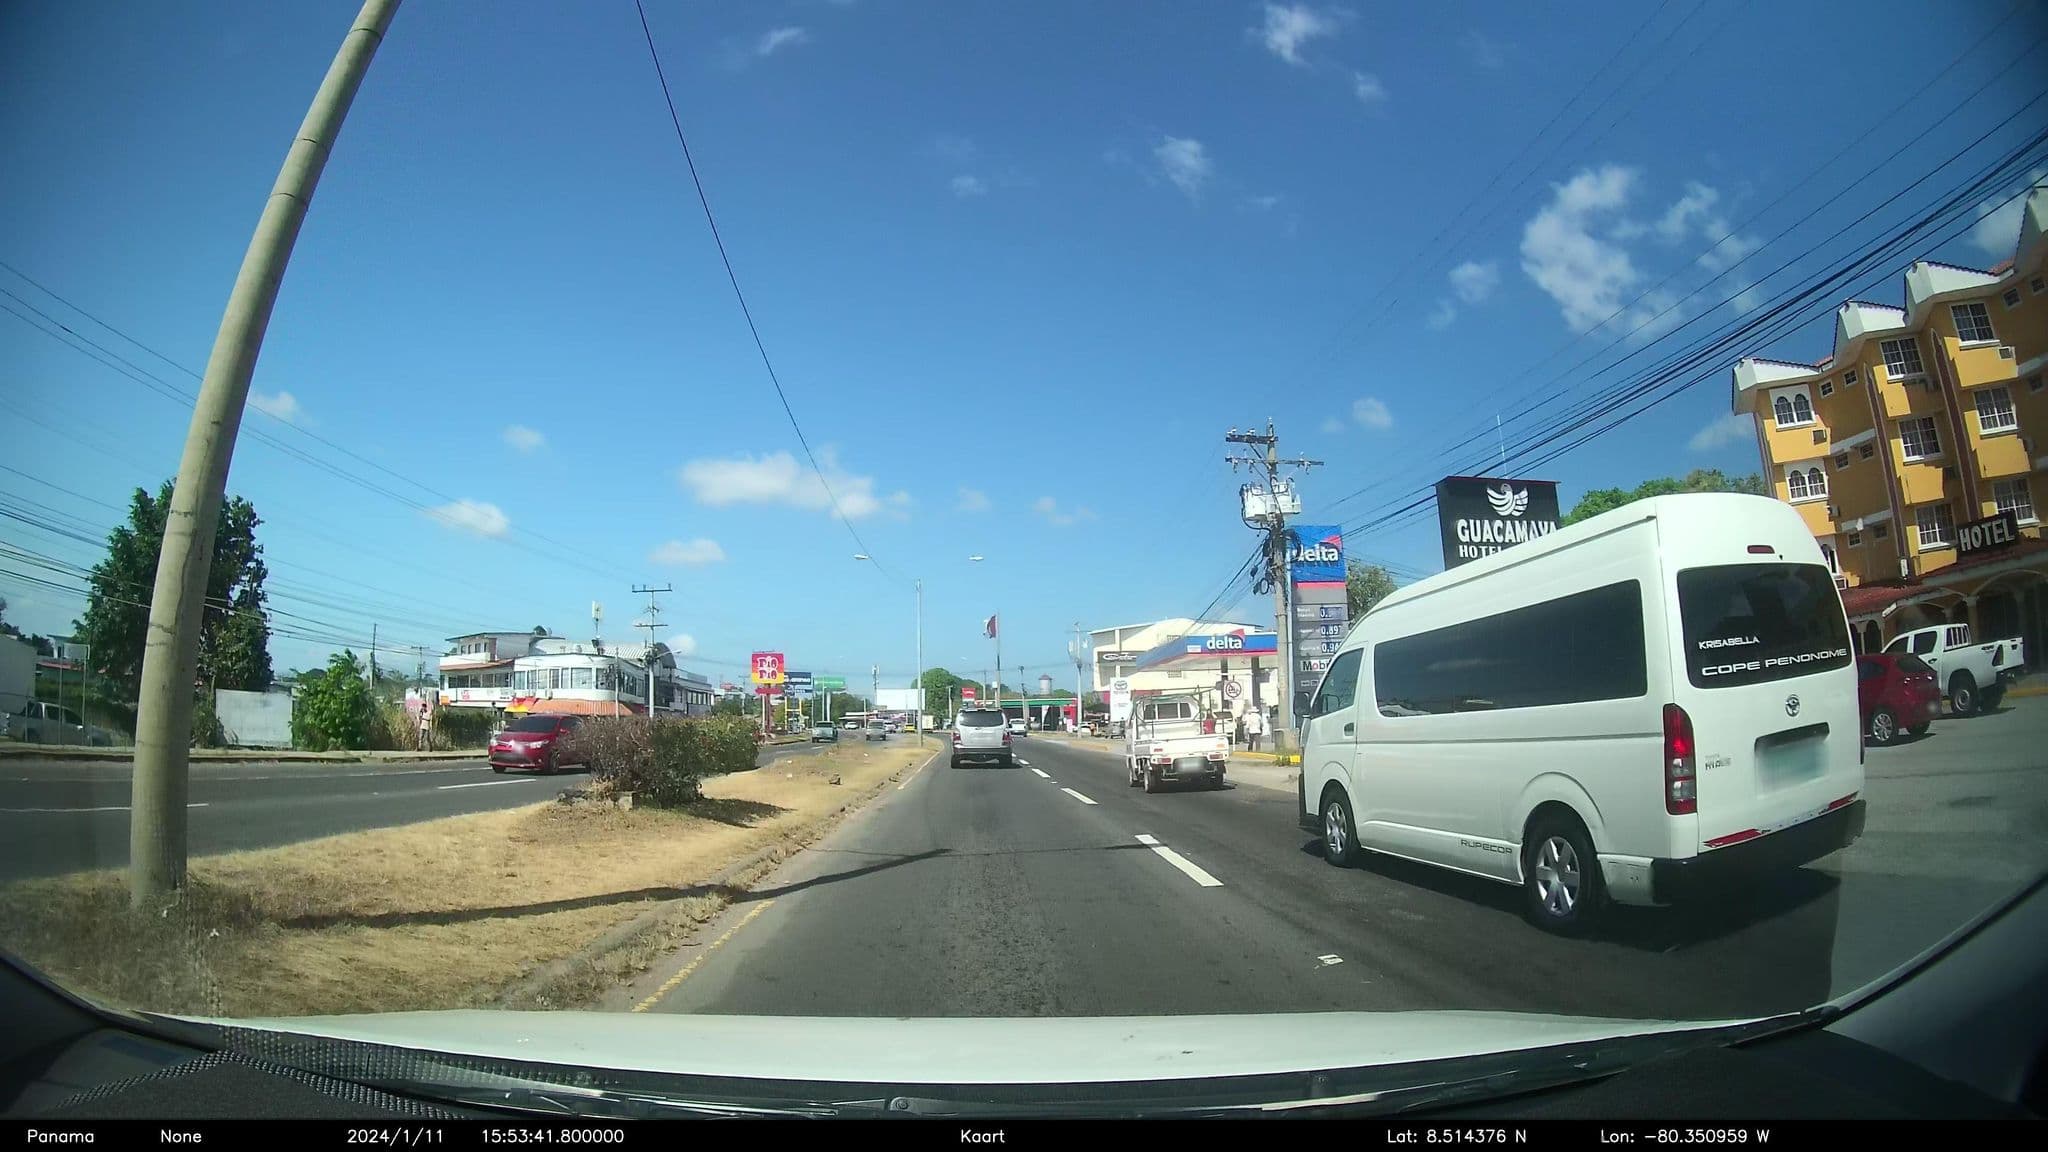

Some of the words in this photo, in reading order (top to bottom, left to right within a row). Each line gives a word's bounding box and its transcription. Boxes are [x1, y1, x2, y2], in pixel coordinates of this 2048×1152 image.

[1959, 518, 2016, 552] HOTEL
[1206, 636, 1243, 650] delta
[1698, 636, 1760, 650] KRISABELLA
[1702, 661, 1761, 676] COPE
[1765, 648, 1848, 668] PENONOME
